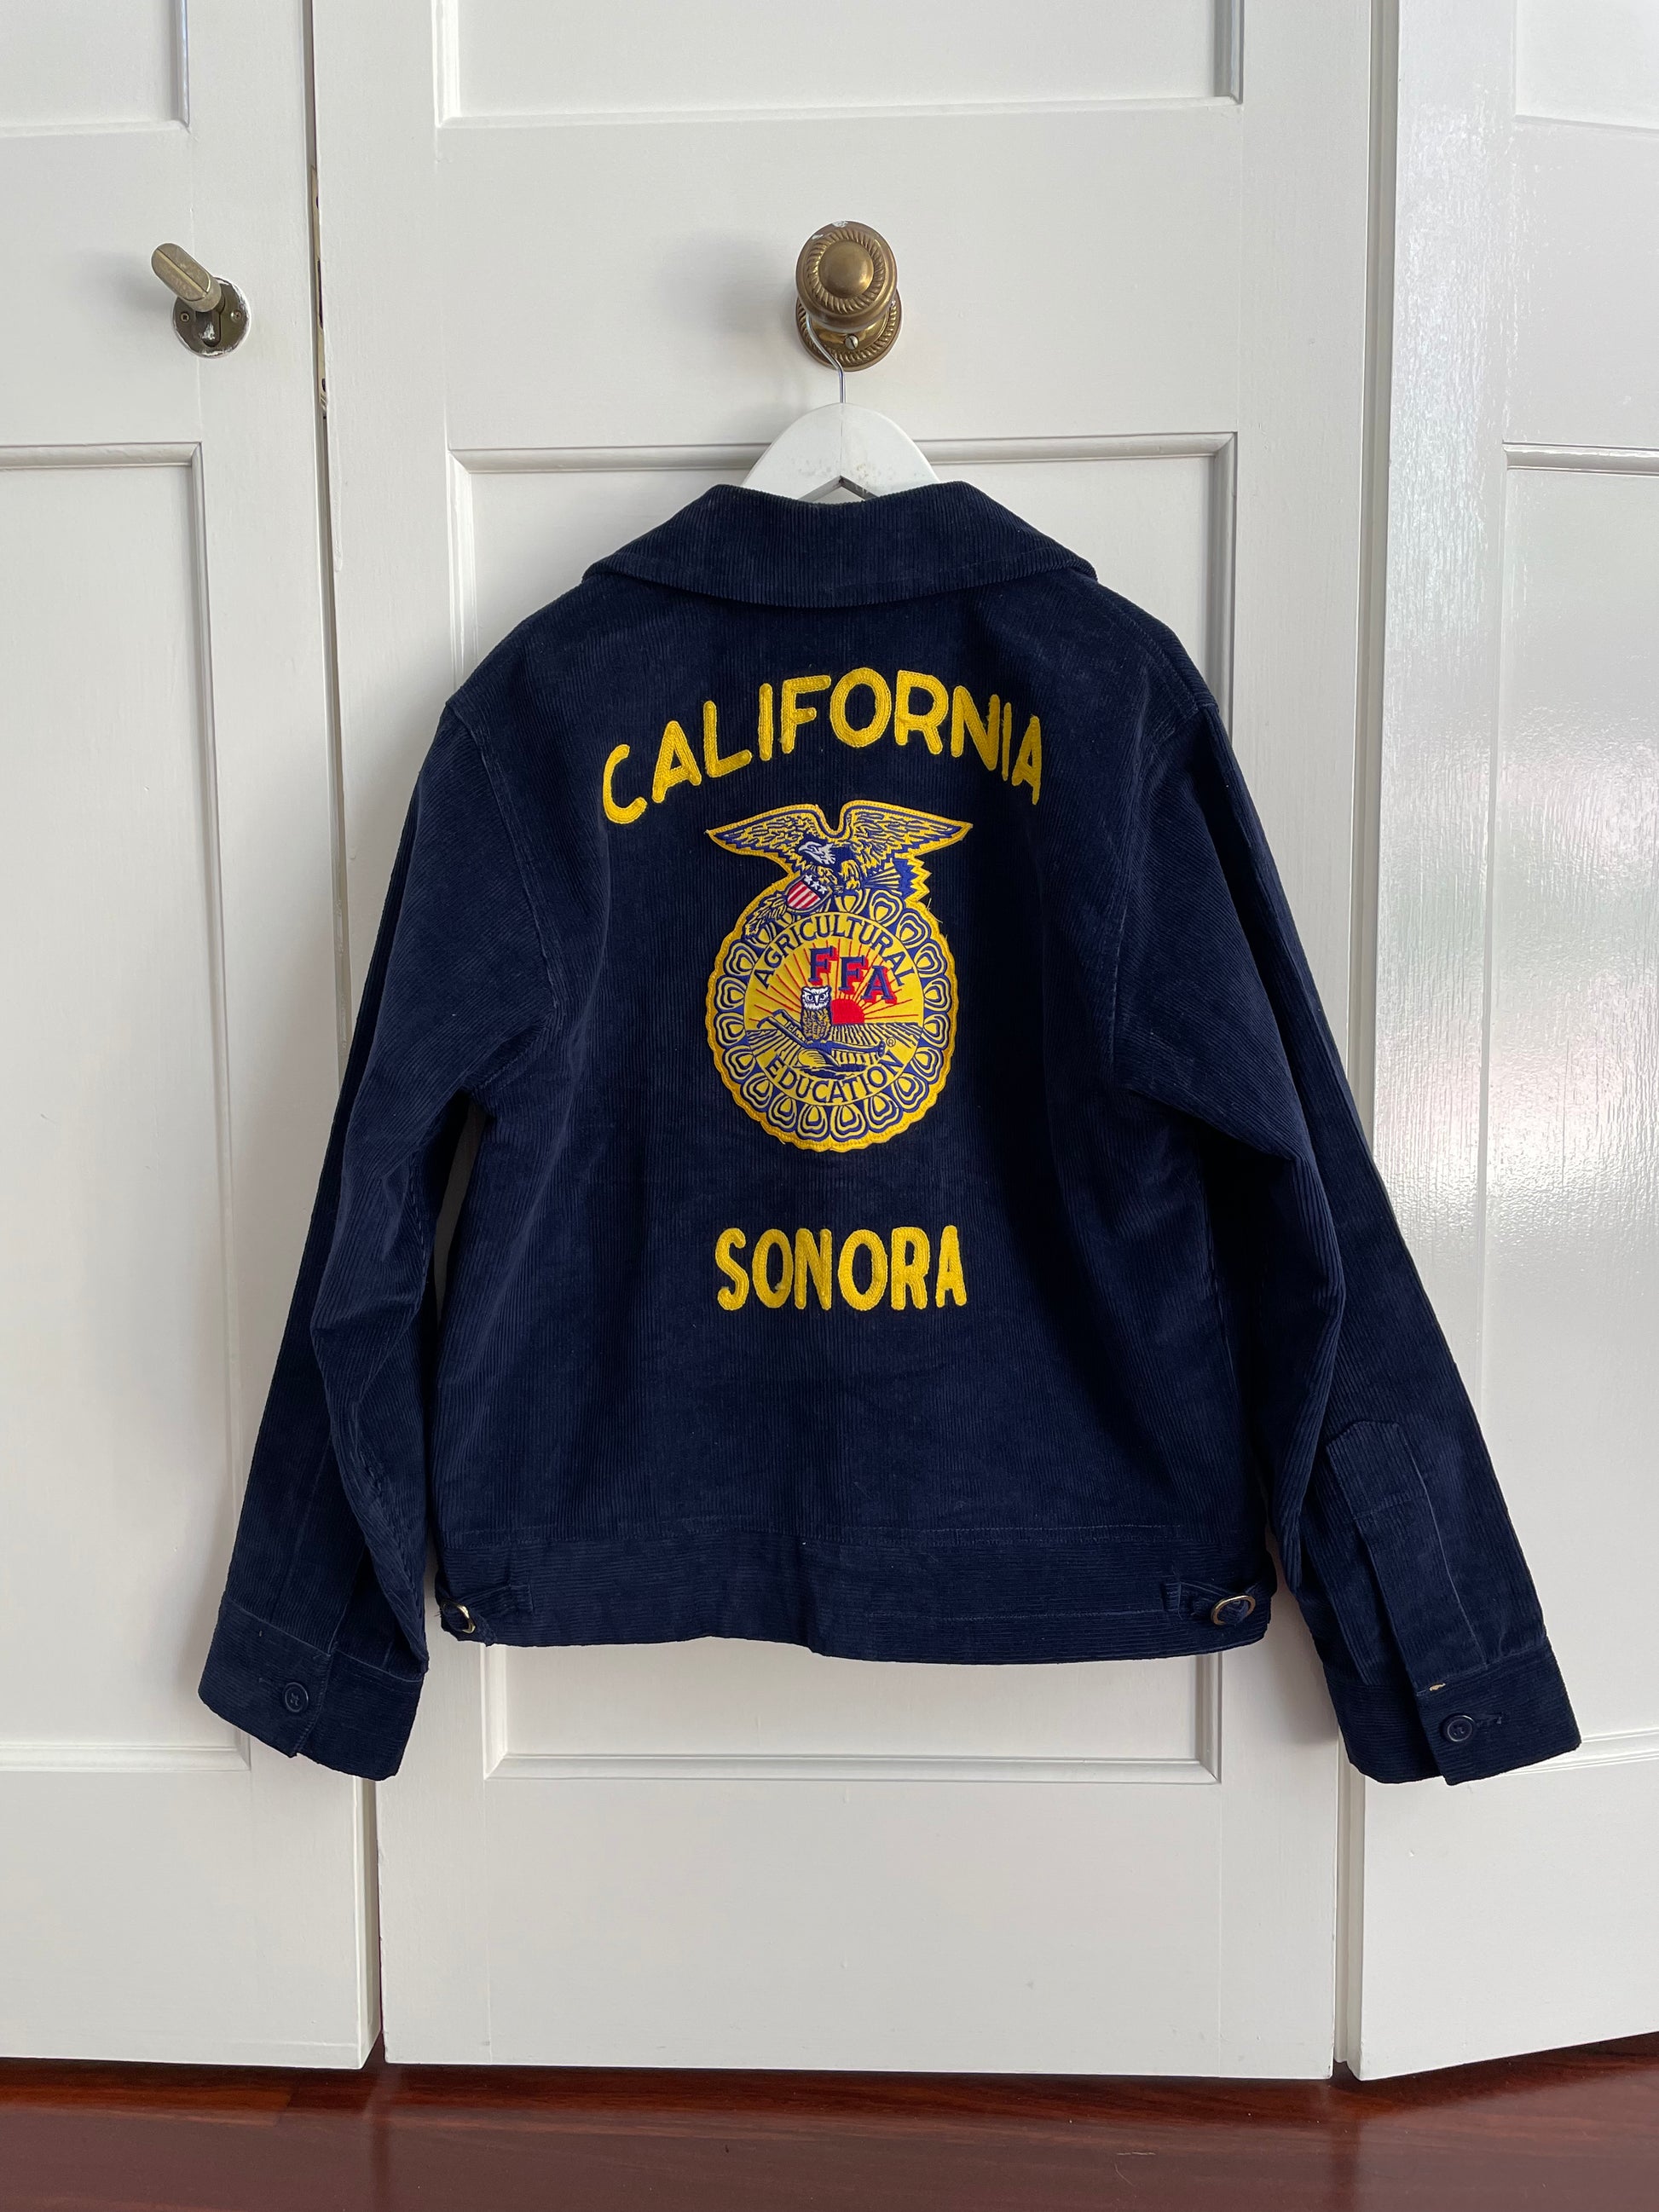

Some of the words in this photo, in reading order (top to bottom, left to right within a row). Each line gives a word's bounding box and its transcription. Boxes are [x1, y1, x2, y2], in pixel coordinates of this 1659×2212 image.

[602, 667, 1042, 824] CALIFORNIA
[753, 915, 915, 989] AGRICULTURAL
[809, 946, 897, 1004] FFA
[766, 1051, 904, 1103] EDUCATION
[714, 1225, 968, 1311] SONORA
